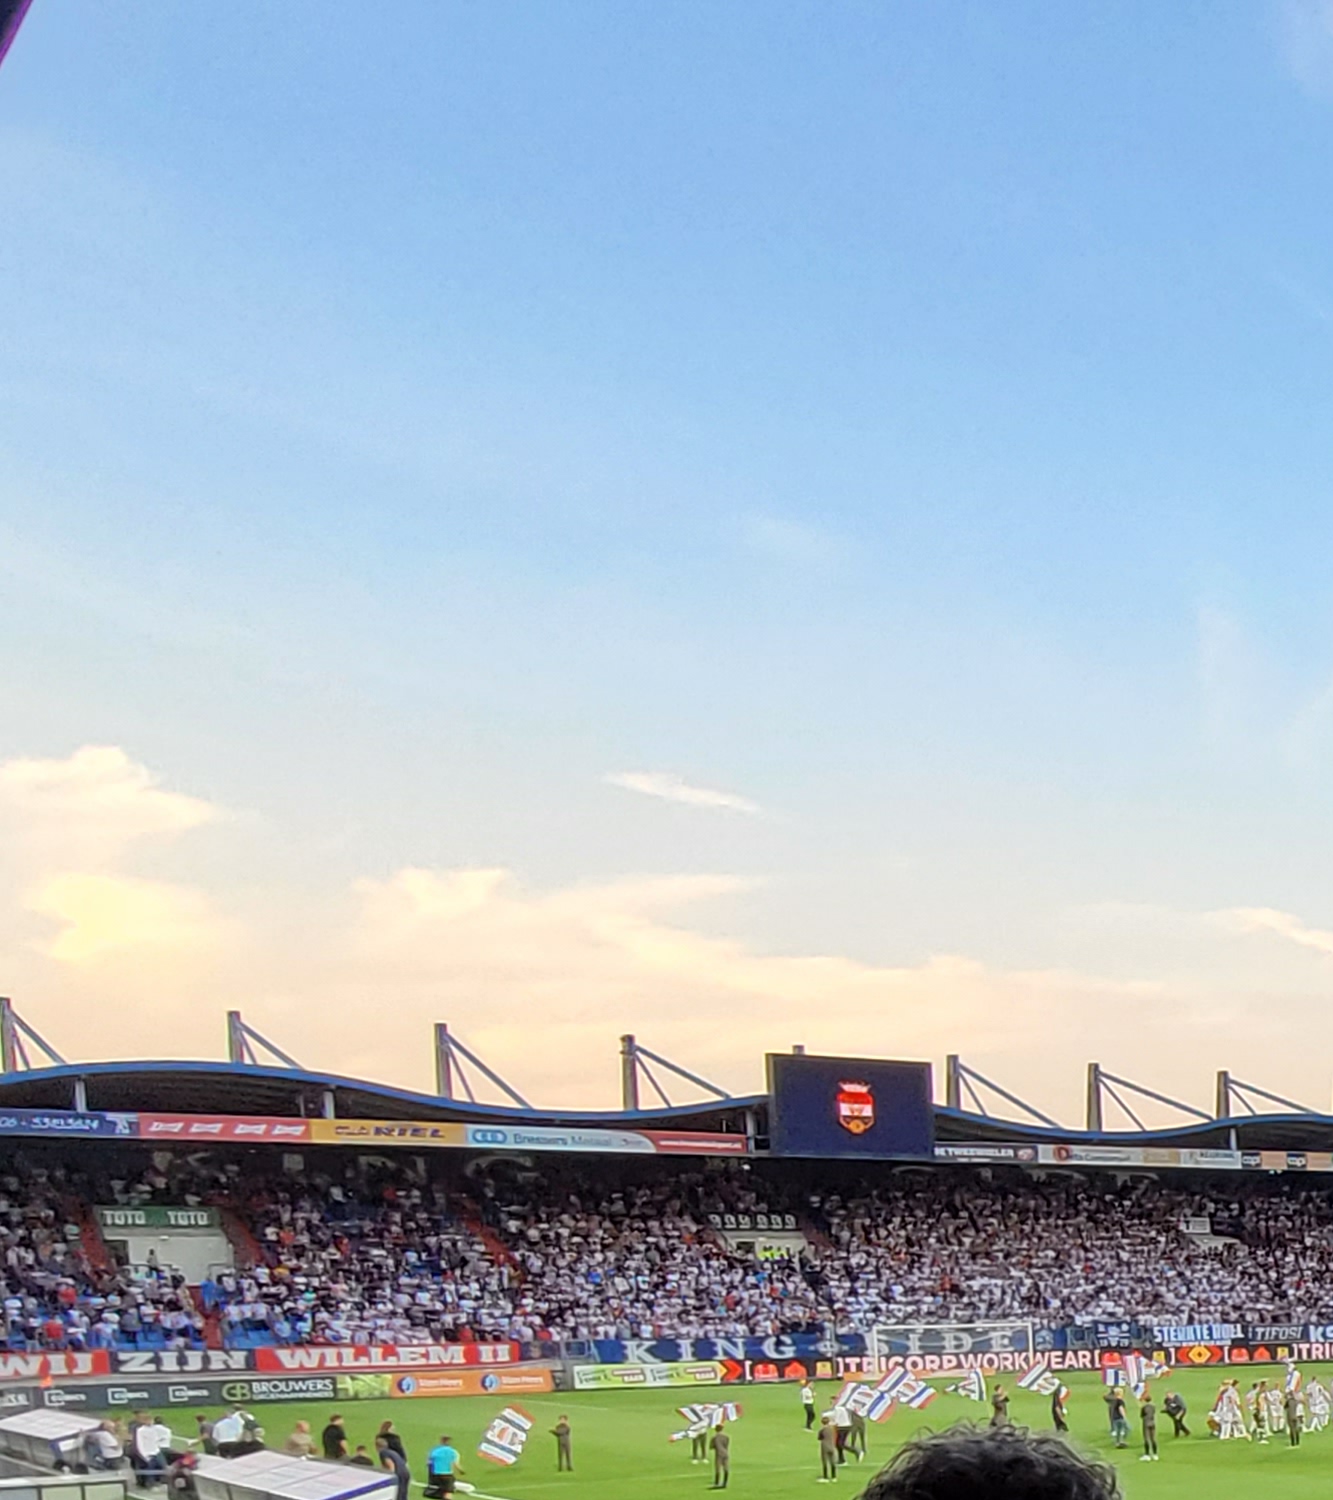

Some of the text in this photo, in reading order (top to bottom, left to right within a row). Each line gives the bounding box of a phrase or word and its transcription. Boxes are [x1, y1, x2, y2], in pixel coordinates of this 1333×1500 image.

[103, 1210, 146, 1225] TOTO
[0, 1344, 511, 1377] WIJ ZIJN WILLEM II
[622, 1335, 796, 1364] KING
[251, 1378, 334, 1392] BROUWERS
